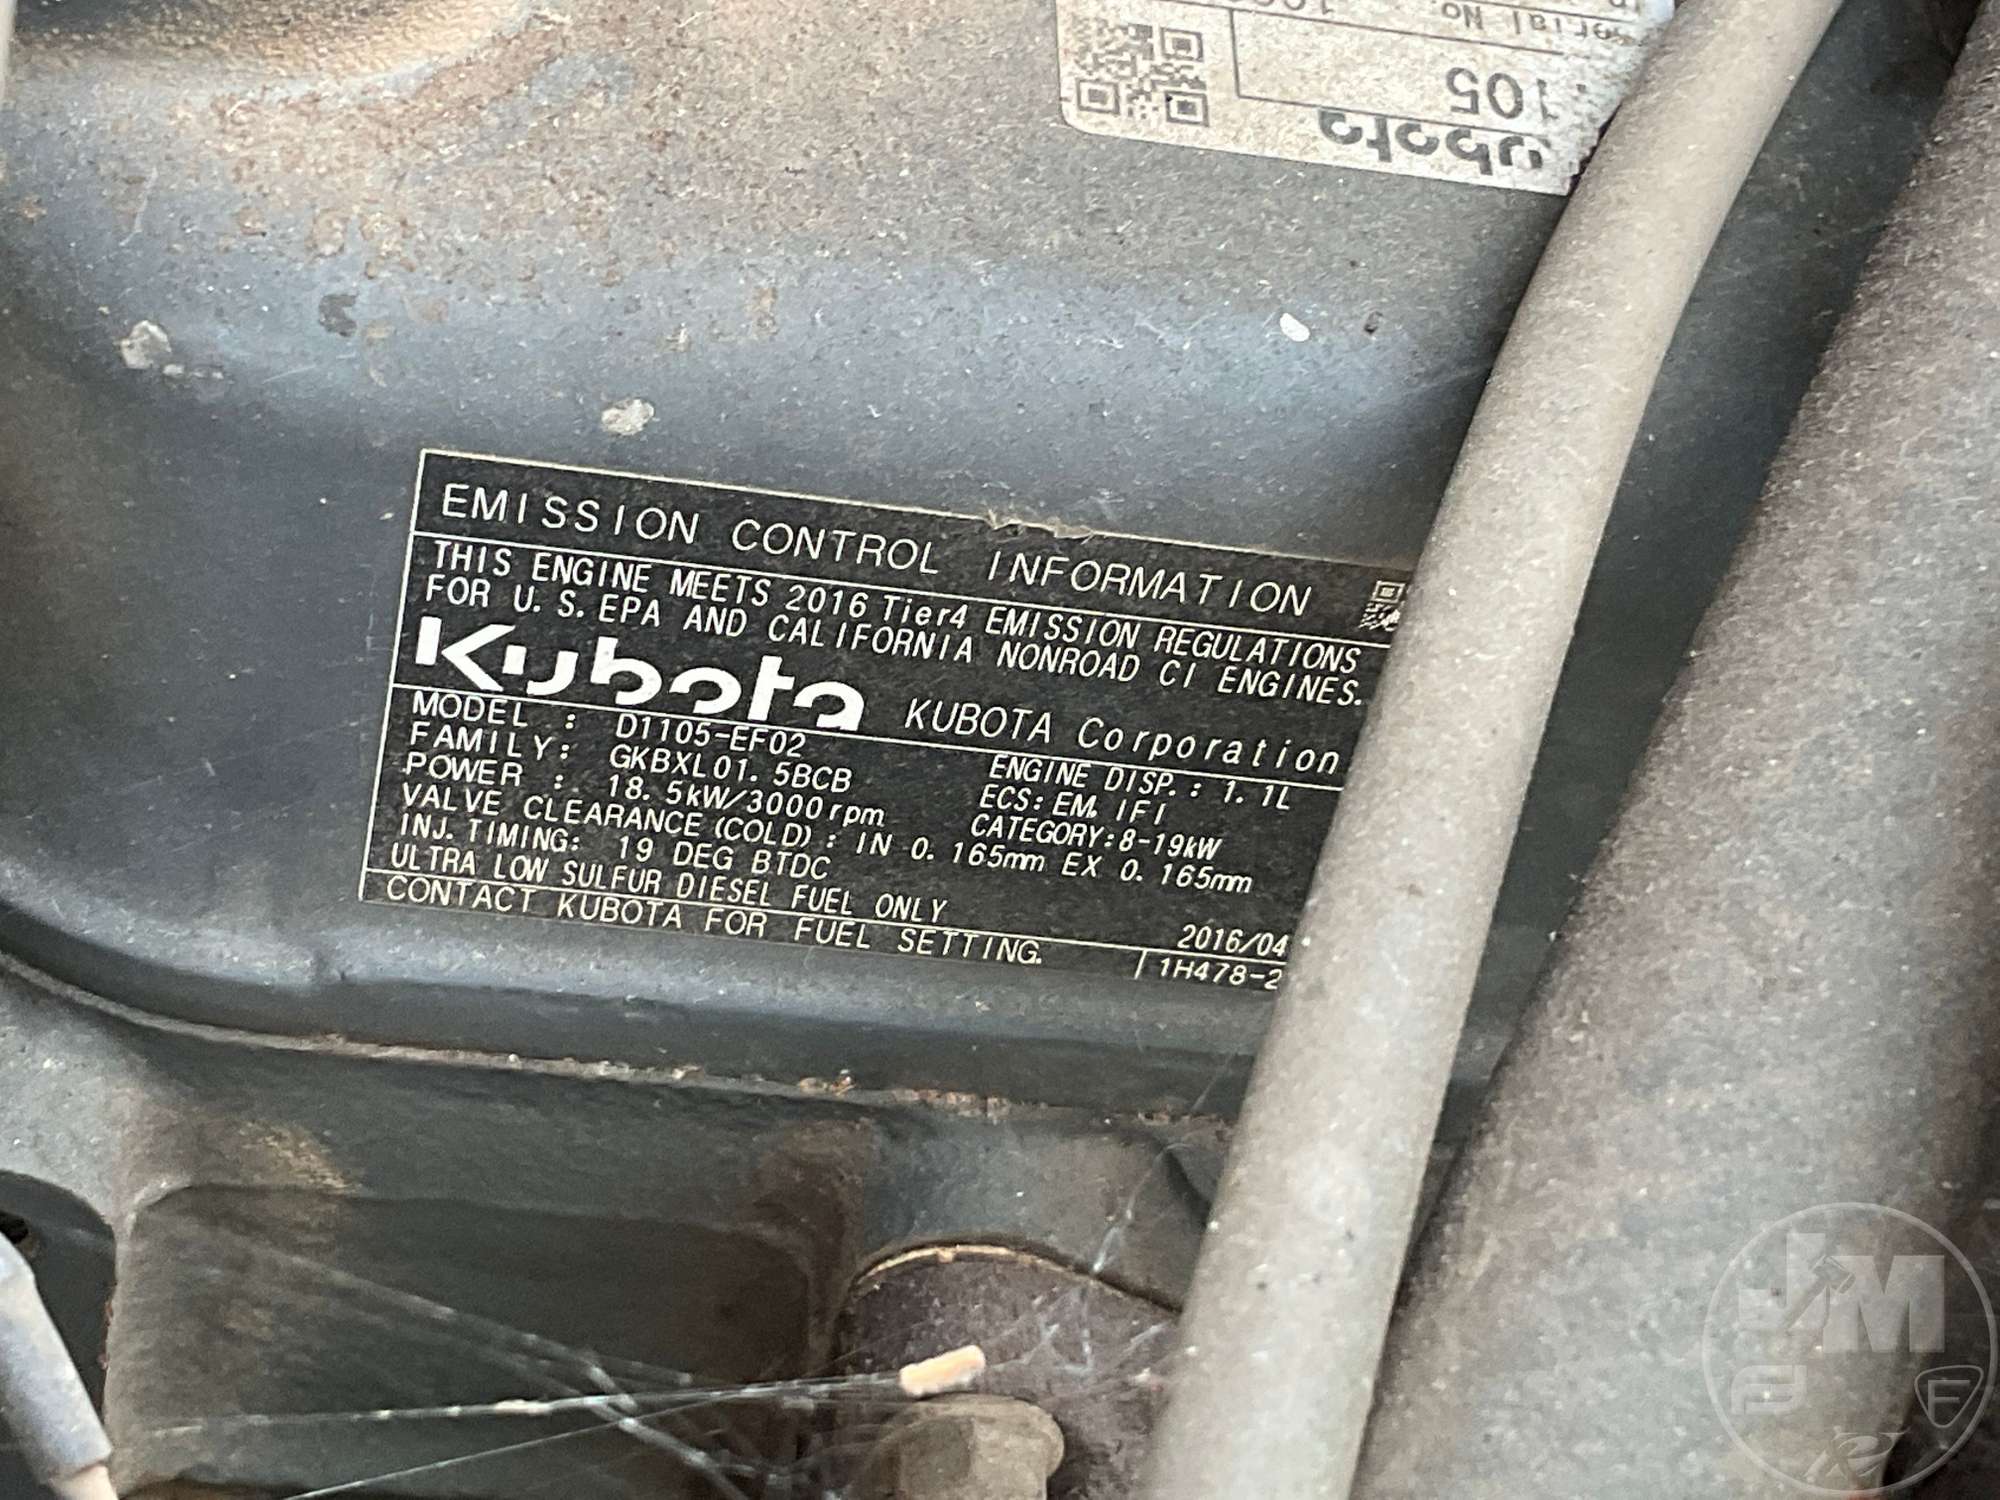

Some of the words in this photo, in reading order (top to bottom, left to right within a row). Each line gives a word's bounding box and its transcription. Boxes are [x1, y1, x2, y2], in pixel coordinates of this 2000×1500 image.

[1318, 107, 1551, 176] ubota
[441, 483, 699, 544] EMISSION
[731, 519, 939, 575] CONTROL
[987, 550, 1312, 616] INFORMATION
[426, 574, 491, 608] FOR
[683, 604, 748, 638] AND
[768, 613, 974, 664] CALIFORNIA
[996, 640, 1140, 682] NONROAD
[1159, 659, 1198, 689] CI
[1217, 666, 1363, 706] ENGINES.
[434, 540, 512, 577] THIS
[531, 552, 651, 593] ENGINE
[669, 568, 771, 607] MEETS
[785, 584, 868, 618] 2016
[884, 594, 969, 630] Tier4
[985, 607, 1141, 649] EMISSION
[1154, 625, 1362, 674] REGULATIONS
[415, 615, 865, 731] Kubota
[410, 720, 570, 760] FAMILY:
[615, 713, 807, 758] D1105-EF02
[904, 698, 1051, 744] KUBOTA
[1078, 716, 1340, 775] Corporation
[989, 754, 1091, 789] ENGINE
[400, 813, 453, 840] INJ.
[468, 817, 580, 852] TIMING:
[619, 836, 654, 862] 19
[673, 841, 735, 871] DEG
[751, 849, 831, 881] BTDC
[402, 782, 502, 816] VALVE
[523, 795, 703, 837] CLEARANCE
[855, 832, 893, 856] IN
[1061, 853, 1102, 878] EX
[386, 875, 537, 914] CONTACT
[557, 893, 682, 930] KUBOTA
[704, 908, 768, 939] FOR
[794, 918, 871, 949] FUEL
[897, 928, 1042, 966] SETTING.
[390, 842, 477, 875] ULTRA
[494, 853, 549, 882] LOW
[561, 859, 663, 895] SULFUR
[676, 872, 771, 908] DIESEL
[791, 883, 853, 916] FUEL
[875, 893, 948, 923] ONLY
[1177, 924, 1290, 957] 2016/04
